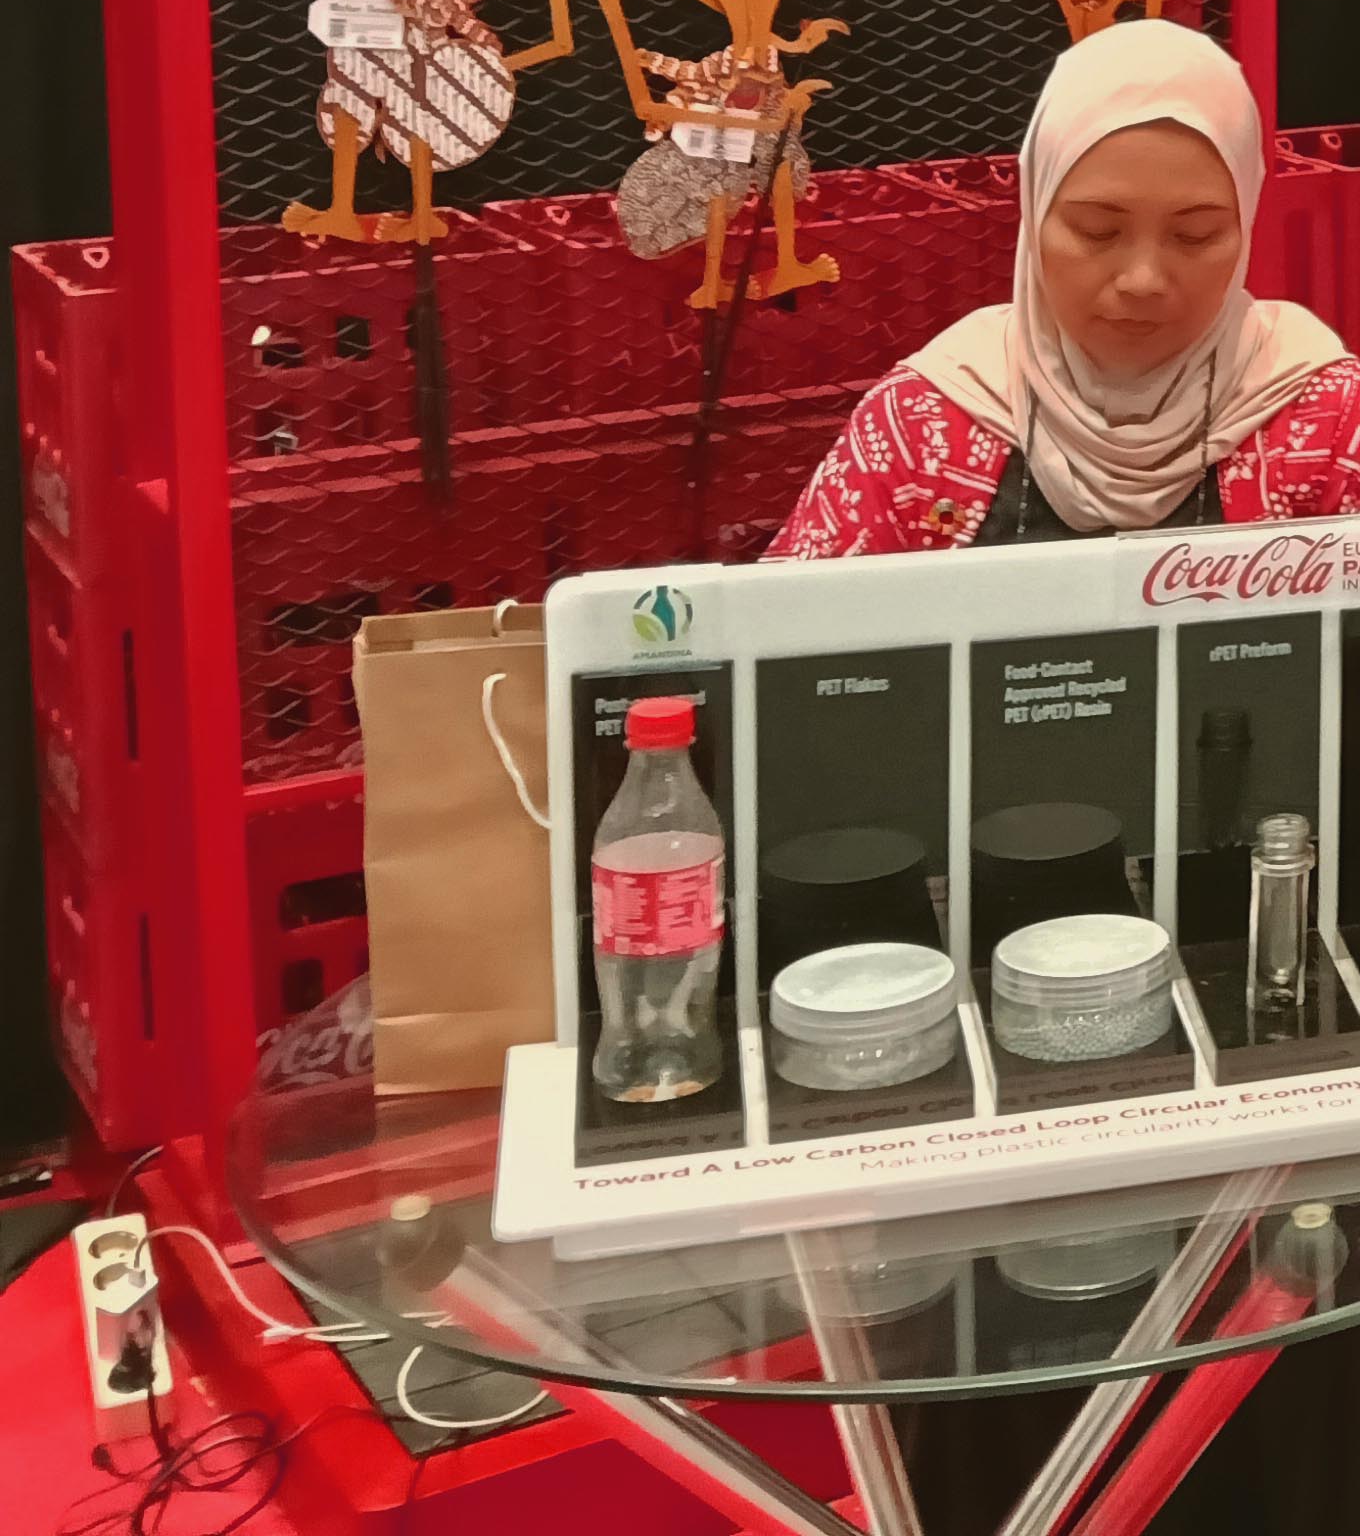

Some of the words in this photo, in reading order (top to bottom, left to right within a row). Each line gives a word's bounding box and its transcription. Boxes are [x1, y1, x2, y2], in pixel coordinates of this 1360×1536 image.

[1141, 532, 1345, 607] Coca-Cola
[816, 678, 843, 696] PET
[595, 718, 622, 736] PET
[1004, 706, 1029, 724] PET
[574, 1166, 690, 1191] Toward
[702, 1163, 723, 1175] A
[734, 1153, 796, 1171] Low
[806, 1139, 916, 1162] Carbon
[926, 1123, 1028, 1145] Closed
[1037, 1113, 1110, 1132] Loop
[1119, 1097, 1228, 1120] Circular
[860, 1148, 967, 1172] Making
[977, 1135, 1072, 1158] plastic
[1081, 1115, 1220, 1143] circularity
[1228, 1102, 1310, 1122] works
[1317, 1095, 1354, 1110] for
